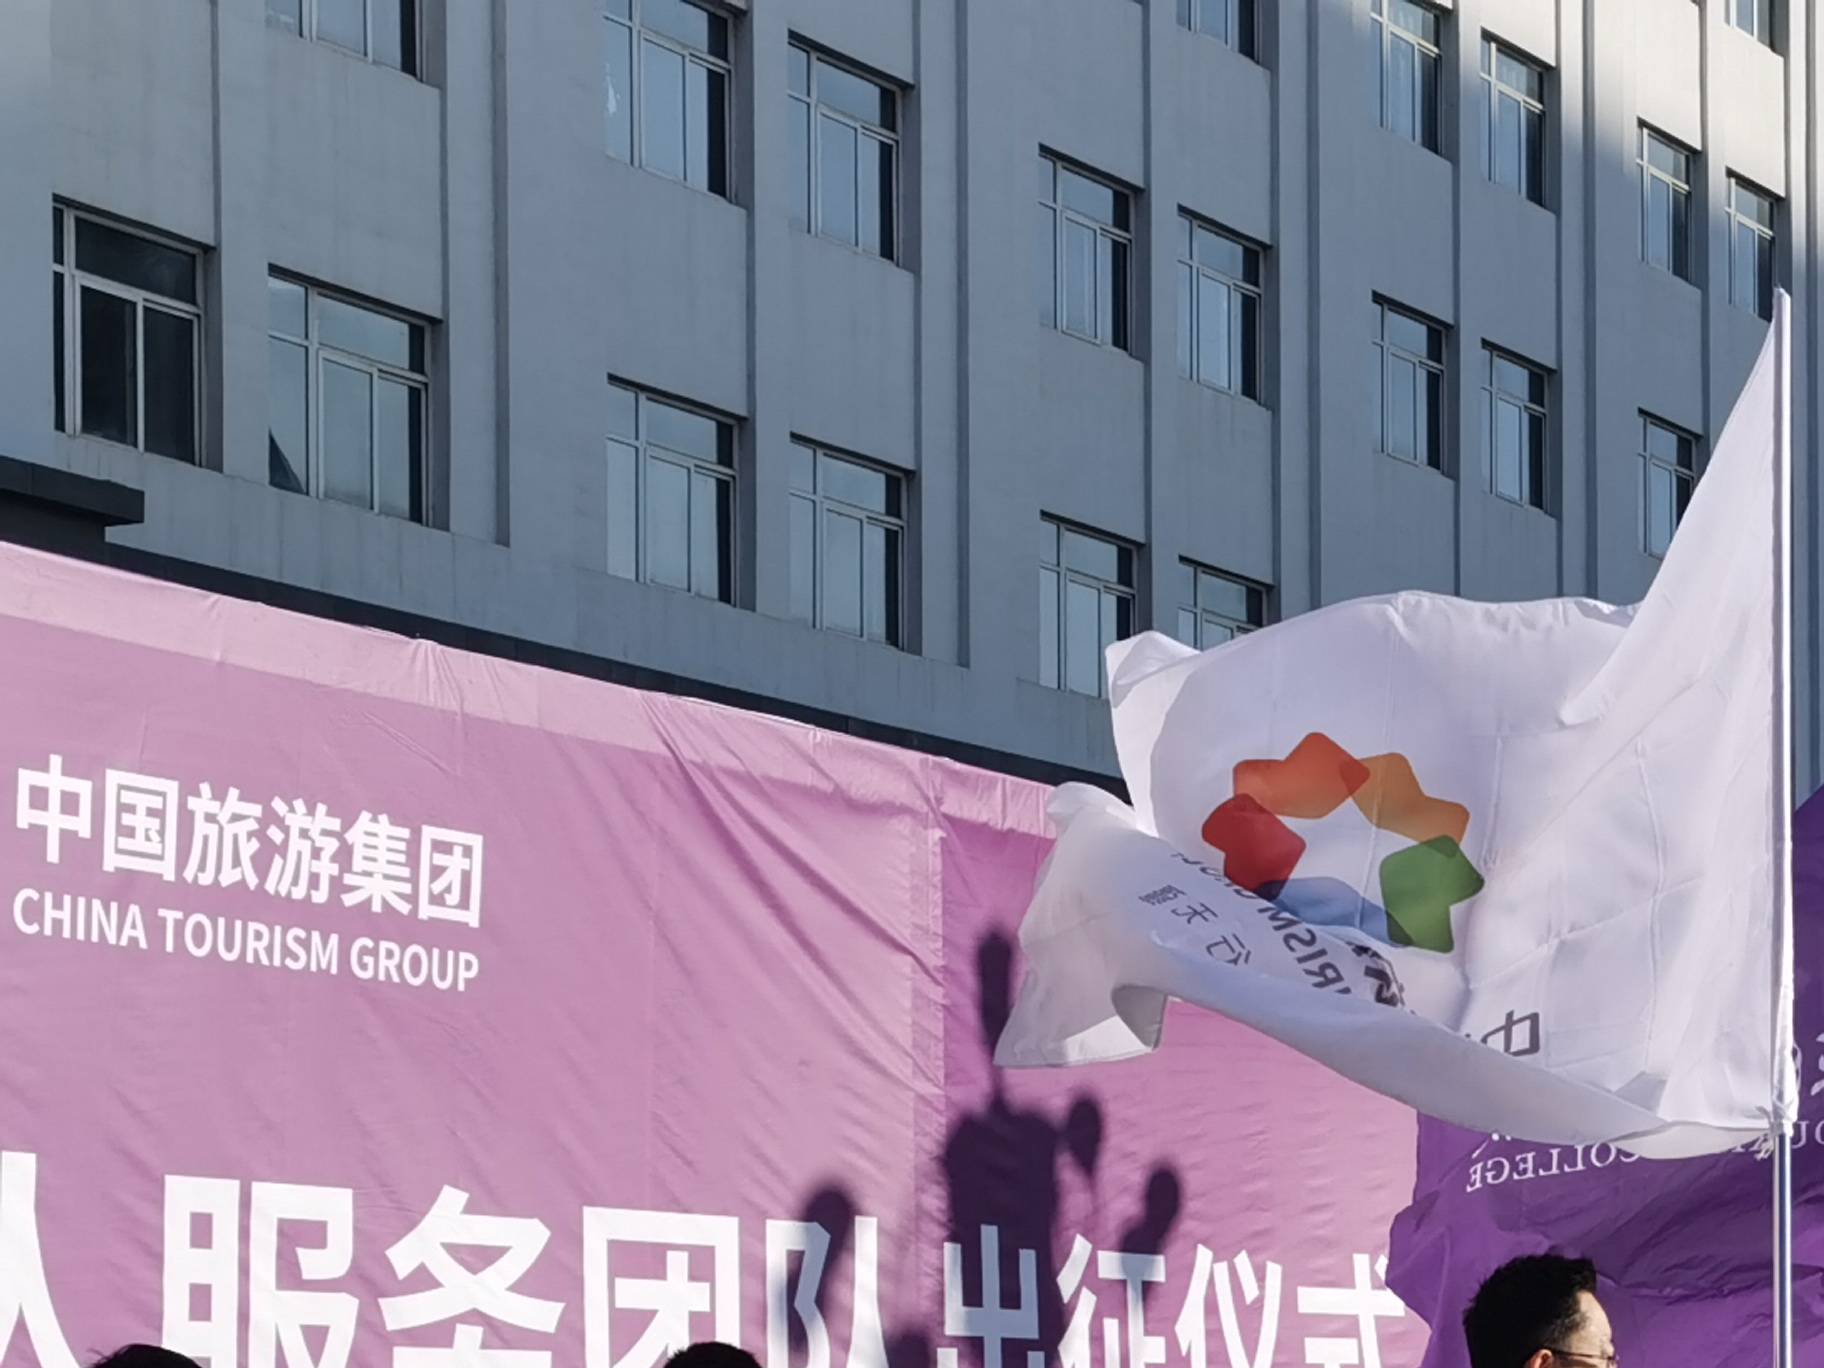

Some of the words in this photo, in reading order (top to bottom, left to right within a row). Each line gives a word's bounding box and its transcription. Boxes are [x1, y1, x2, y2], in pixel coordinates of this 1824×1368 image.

[16, 753, 484, 928] 中国旅游集团
[13, 887, 148, 949] CHINA
[157, 907, 339, 975] TOURISM
[349, 936, 480, 992] GROUP
